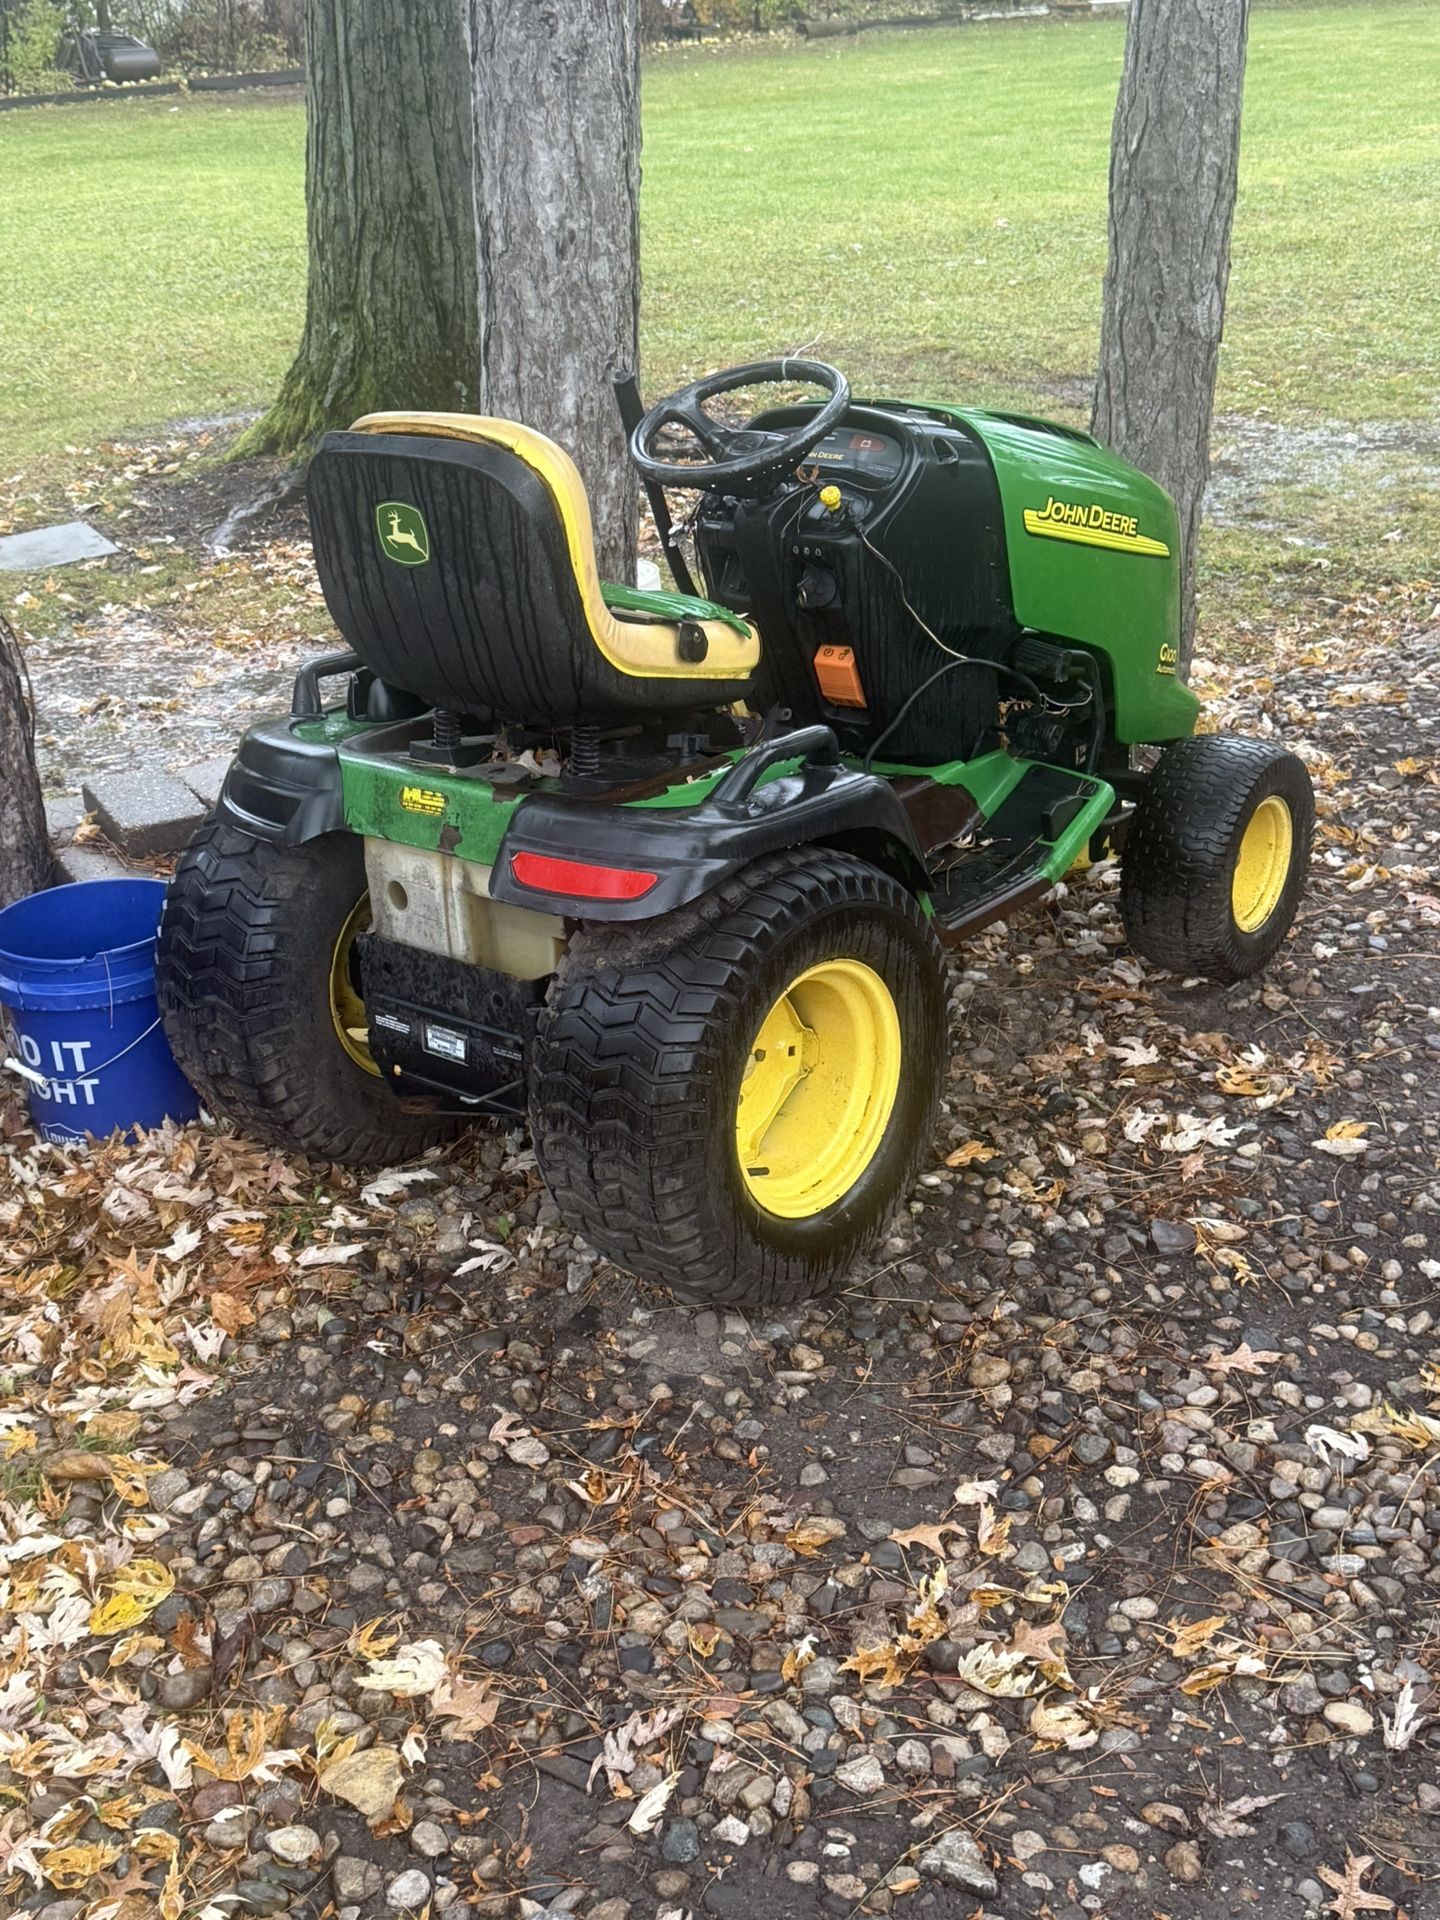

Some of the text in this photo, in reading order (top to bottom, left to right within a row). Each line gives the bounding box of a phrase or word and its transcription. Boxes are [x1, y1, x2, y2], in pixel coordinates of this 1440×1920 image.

[817, 451, 845, 461] DEERE
[1037, 496, 1138, 535] JOHN DEERE
[51, 1041, 91, 1072] IT
[27, 1077, 99, 1105] IGHT
